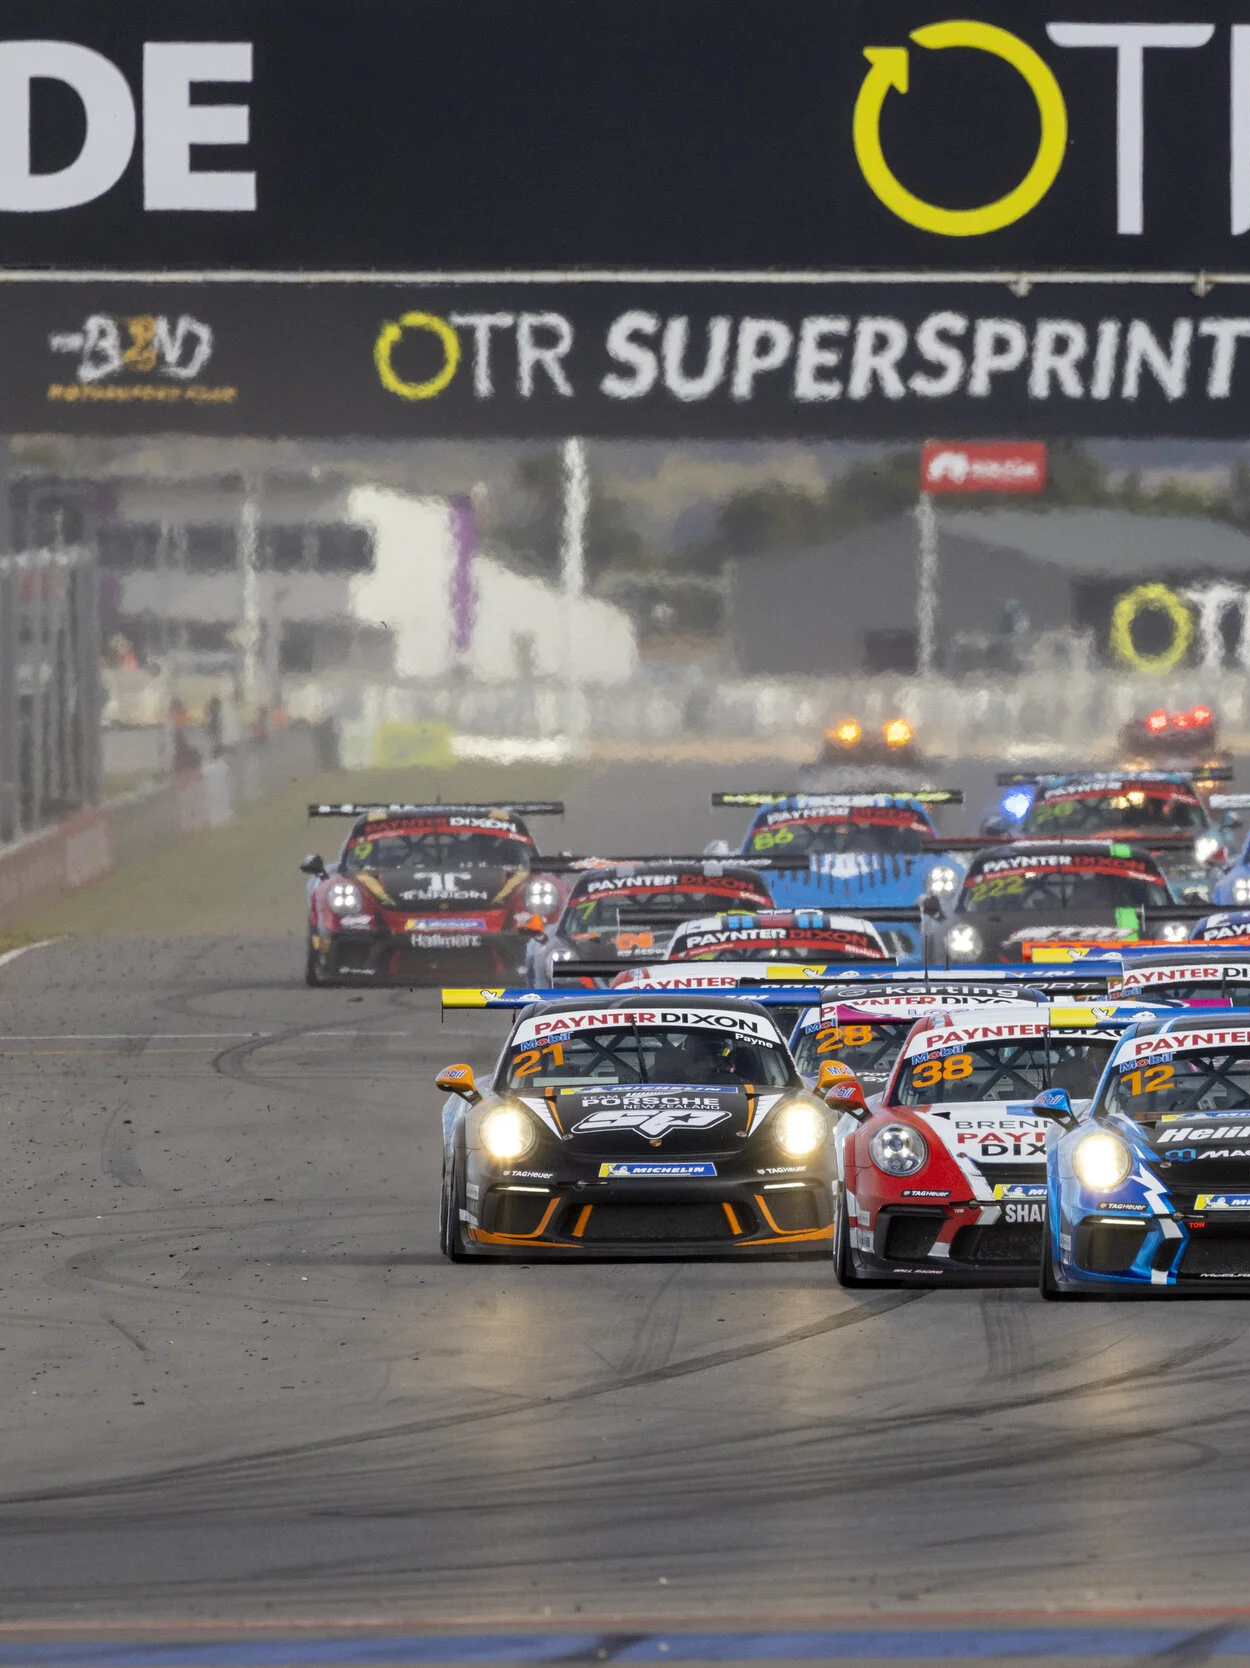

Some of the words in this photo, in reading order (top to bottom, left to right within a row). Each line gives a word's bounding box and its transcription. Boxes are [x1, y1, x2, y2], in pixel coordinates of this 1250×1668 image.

[375, 311, 574, 399] OTR
[449, 816, 518, 833] DIXON
[983, 855, 1072, 874] PAYNTER
[587, 874, 678, 893] PAYNTER
[686, 928, 788, 948] PAYNTER
[788, 928, 868, 947] DIXON
[1108, 967, 1219, 990] PAYNTER
[534, 1012, 656, 1036] PAYNTER
[660, 1012, 759, 1034] DIXON
[520, 1031, 573, 1052] Mobil
[734, 1033, 774, 1049] Payne
[815, 1024, 873, 1054] 28
[926, 1024, 1050, 1049] PAYNTER
[511, 1043, 565, 1079] 21
[911, 1044, 966, 1066] Mobil
[1119, 1051, 1175, 1074] Mobil
[911, 1054, 974, 1089] 38
[1120, 1064, 1176, 1097] 12
[582, 1097, 720, 1108] PORSCHE
[658, 1103, 720, 1111] ZEALAND
[632, 1165, 706, 1174] MICHELIN
[1188, 1221, 1206, 1229] TOW
